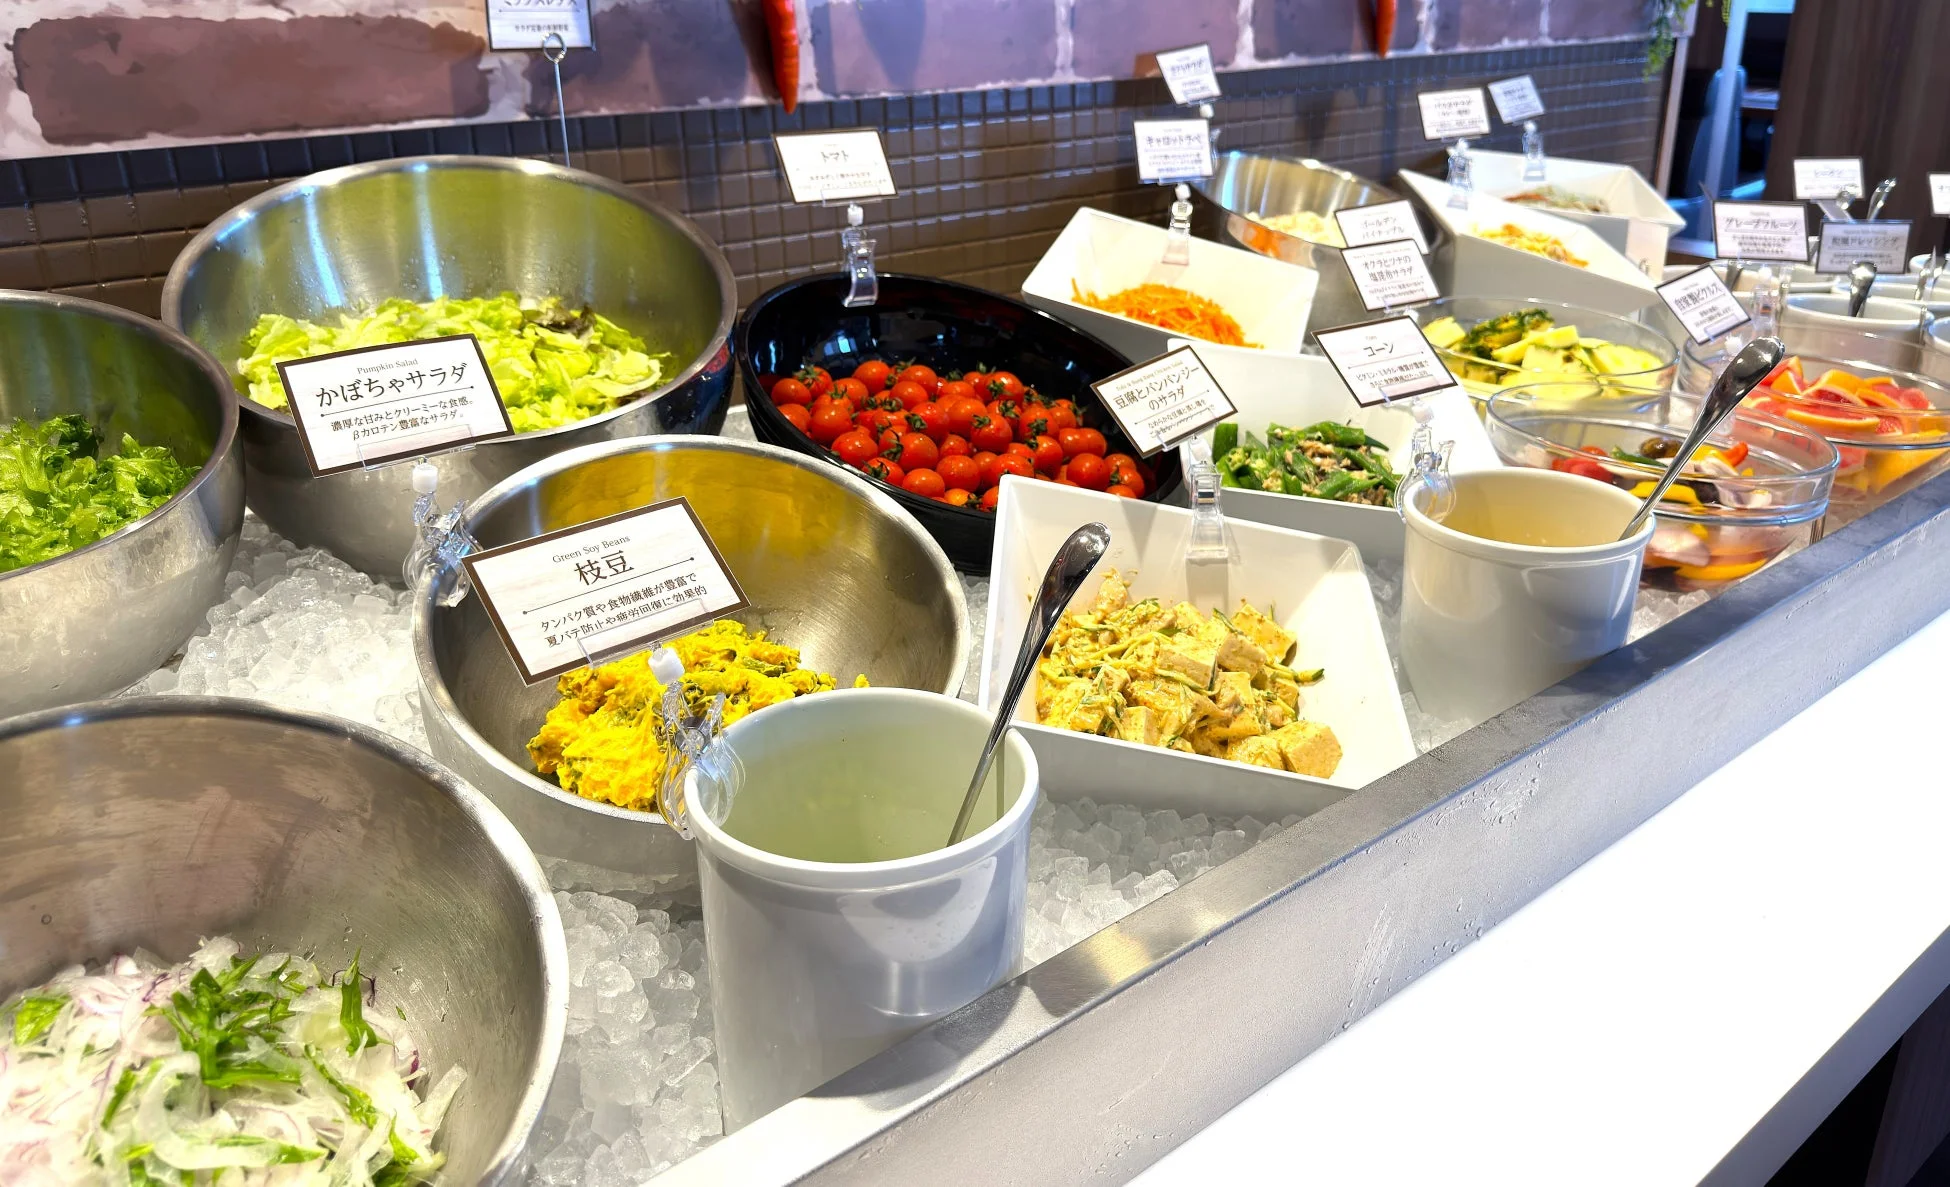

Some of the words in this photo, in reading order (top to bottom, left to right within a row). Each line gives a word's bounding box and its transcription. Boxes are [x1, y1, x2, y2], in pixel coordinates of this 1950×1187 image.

[821, 150, 849, 163] トマト
[1725, 217, 1797, 230] グレープフルーツ
[1363, 342, 1395, 357] コーン
[357, 362, 395, 375] Pumpkin
[395, 358, 420, 369] Salad
[316, 362, 468, 408] かぼちゃサラダ
[1113, 366, 1200, 410] 豆腐とバンバンジー
[1149, 386, 1186, 411] のサラダ
[331, 396, 474, 432] 濃厚な甘みとクリーミーな食感。
[552, 549, 582, 565] Green
[582, 544, 601, 558] Soy
[601, 534, 631, 550] Beans
[574, 550, 635, 585] 枝豆
[541, 572, 697, 632] タンパク質や食物繊維が豊富で
